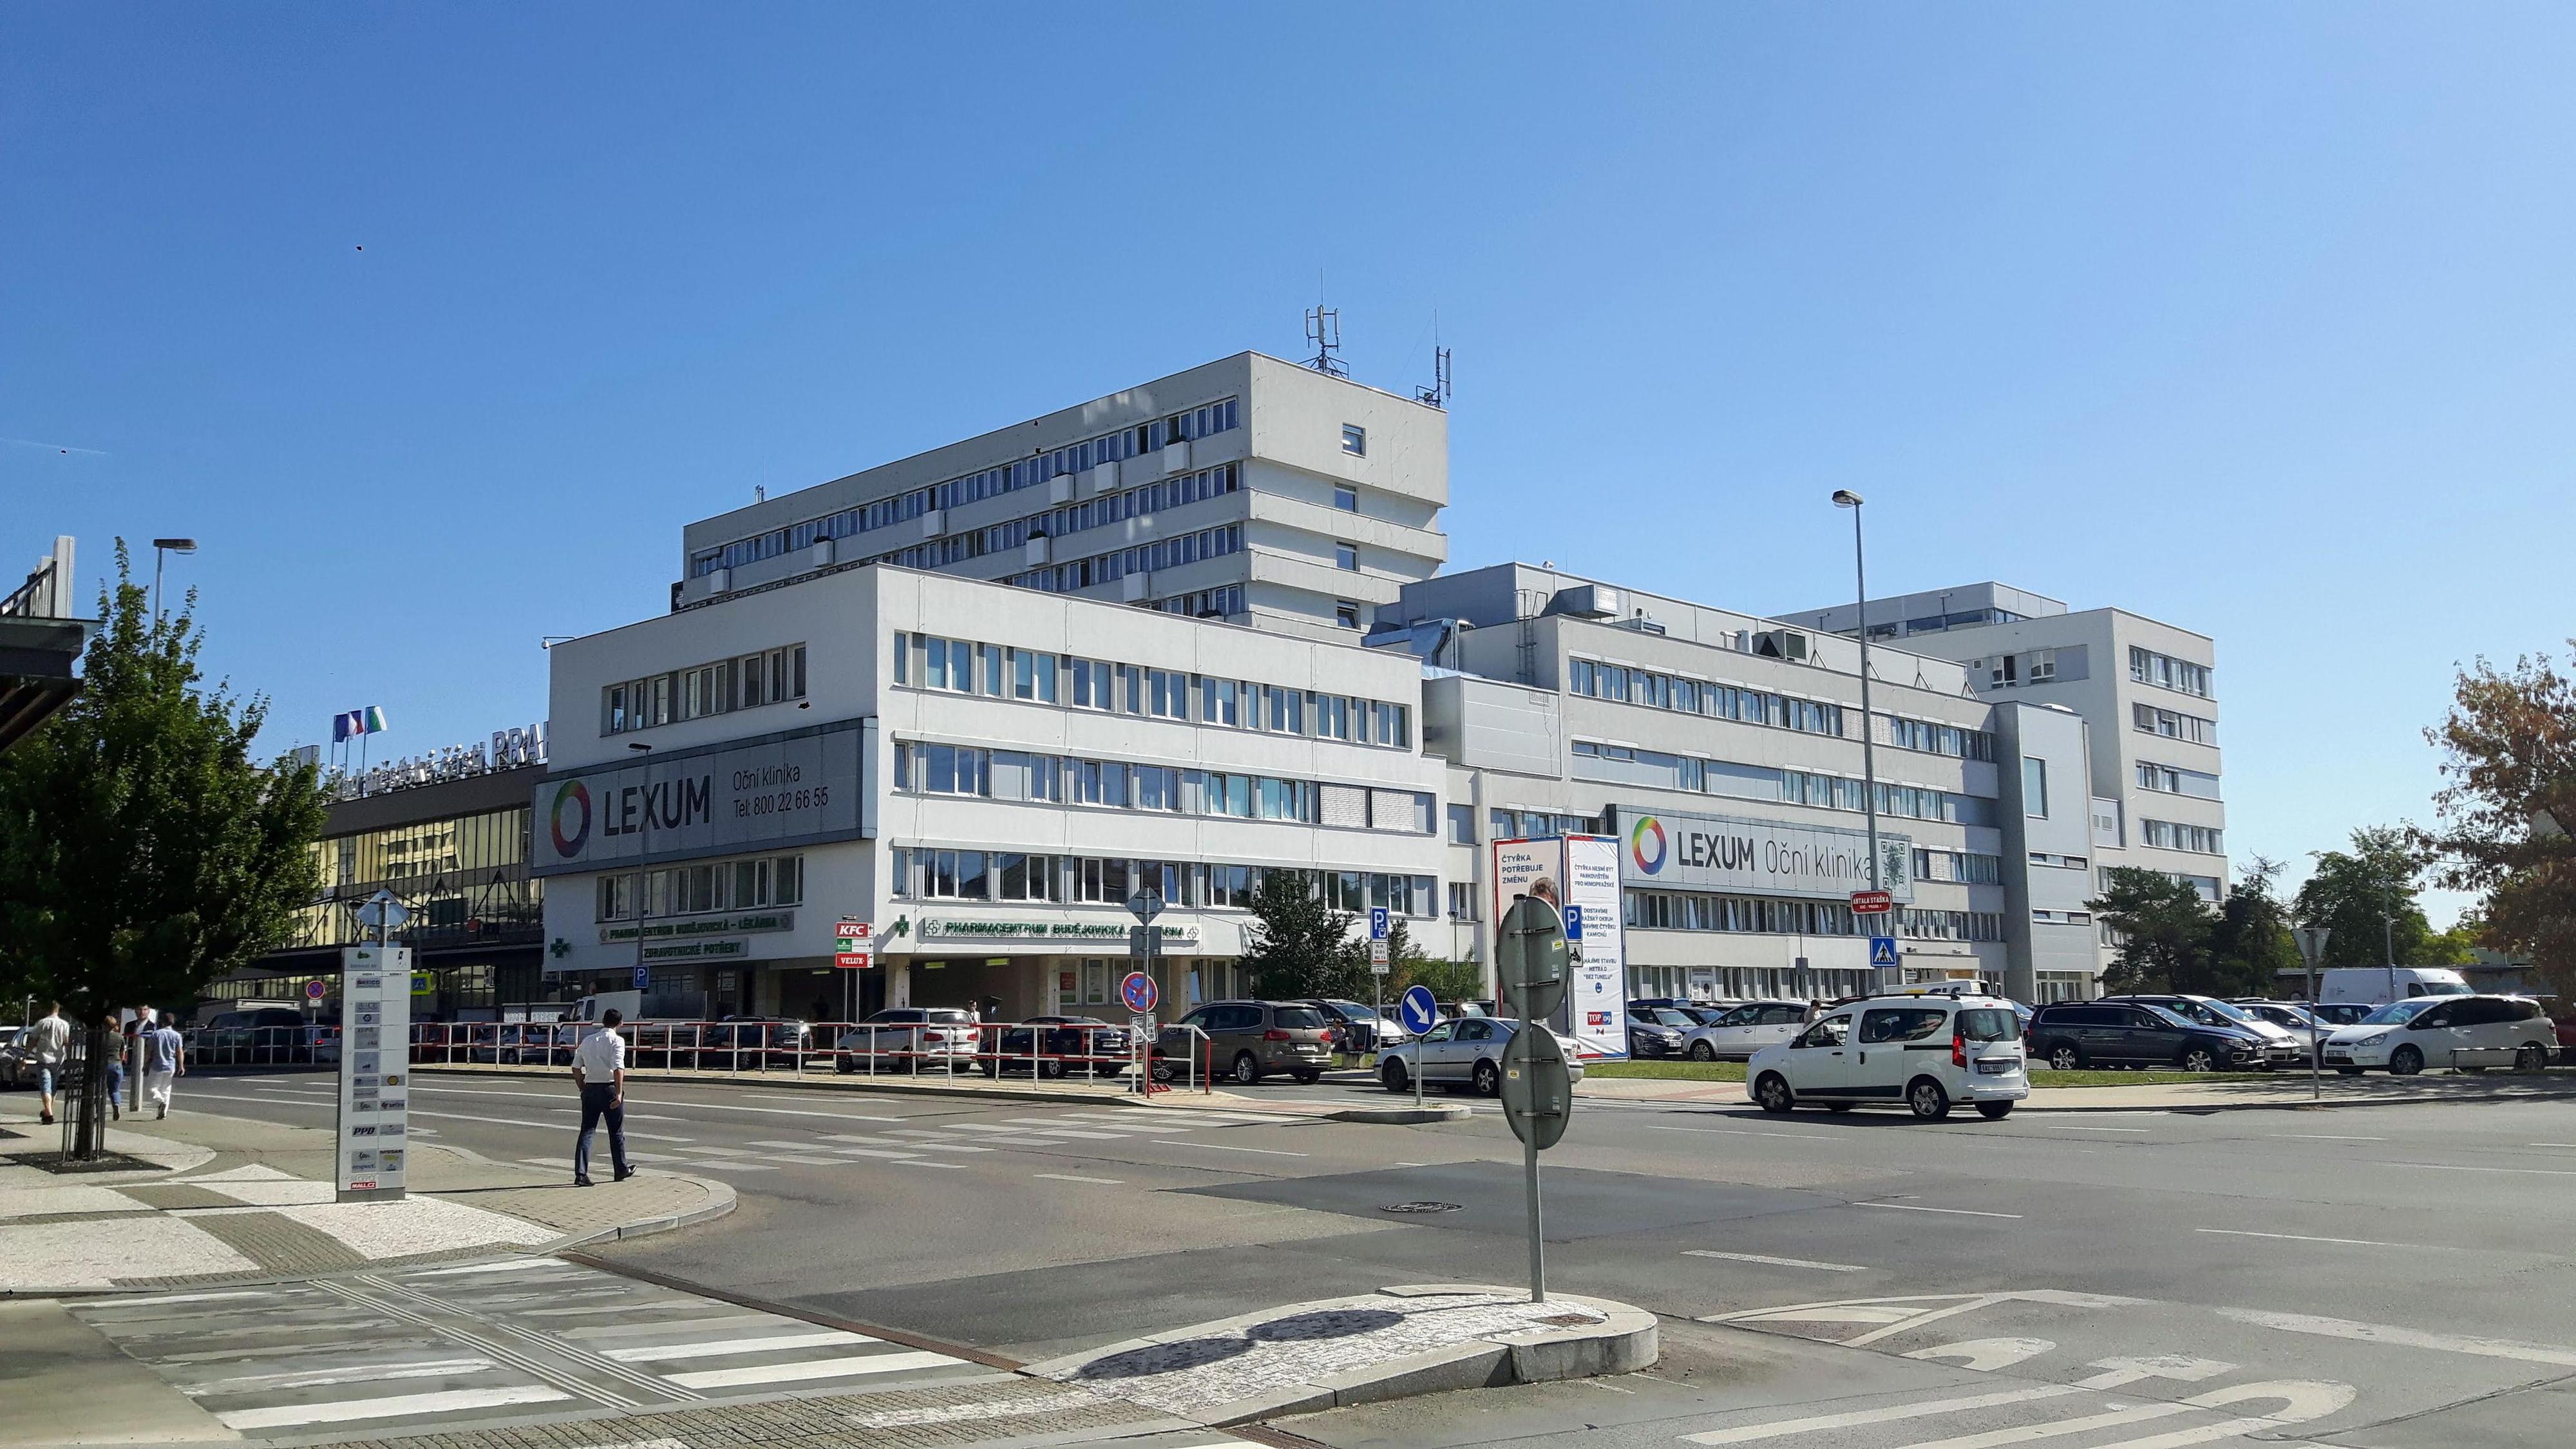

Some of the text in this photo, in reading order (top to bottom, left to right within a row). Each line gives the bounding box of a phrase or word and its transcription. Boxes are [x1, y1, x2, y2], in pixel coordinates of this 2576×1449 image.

[733, 762, 800, 791] Oční klinika
[604, 775, 710, 837] LEXUM
[734, 786, 828, 818] Tel: 800 22 66 55
[1502, 853, 1531, 863] ČTYŘKA
[1677, 831, 1871, 880] LEXUM Oční klinika
[1502, 864, 1543, 873] POTŘEBUJE
[1502, 875, 1528, 884] ZMĚNU
[1374, 911, 1384, 930] P
[1567, 909, 1578, 930] P
[609, 925, 673, 940] PHARMAENTRUM
[839, 925, 864, 935] KFC
[945, 922, 1048, 935] PHARMACENTRUM
[1052, 922, 1126, 936] BUDĚJOVICKÁ
[703, 941, 741, 955] POTŘEBY
[638, 969, 645, 981] P
